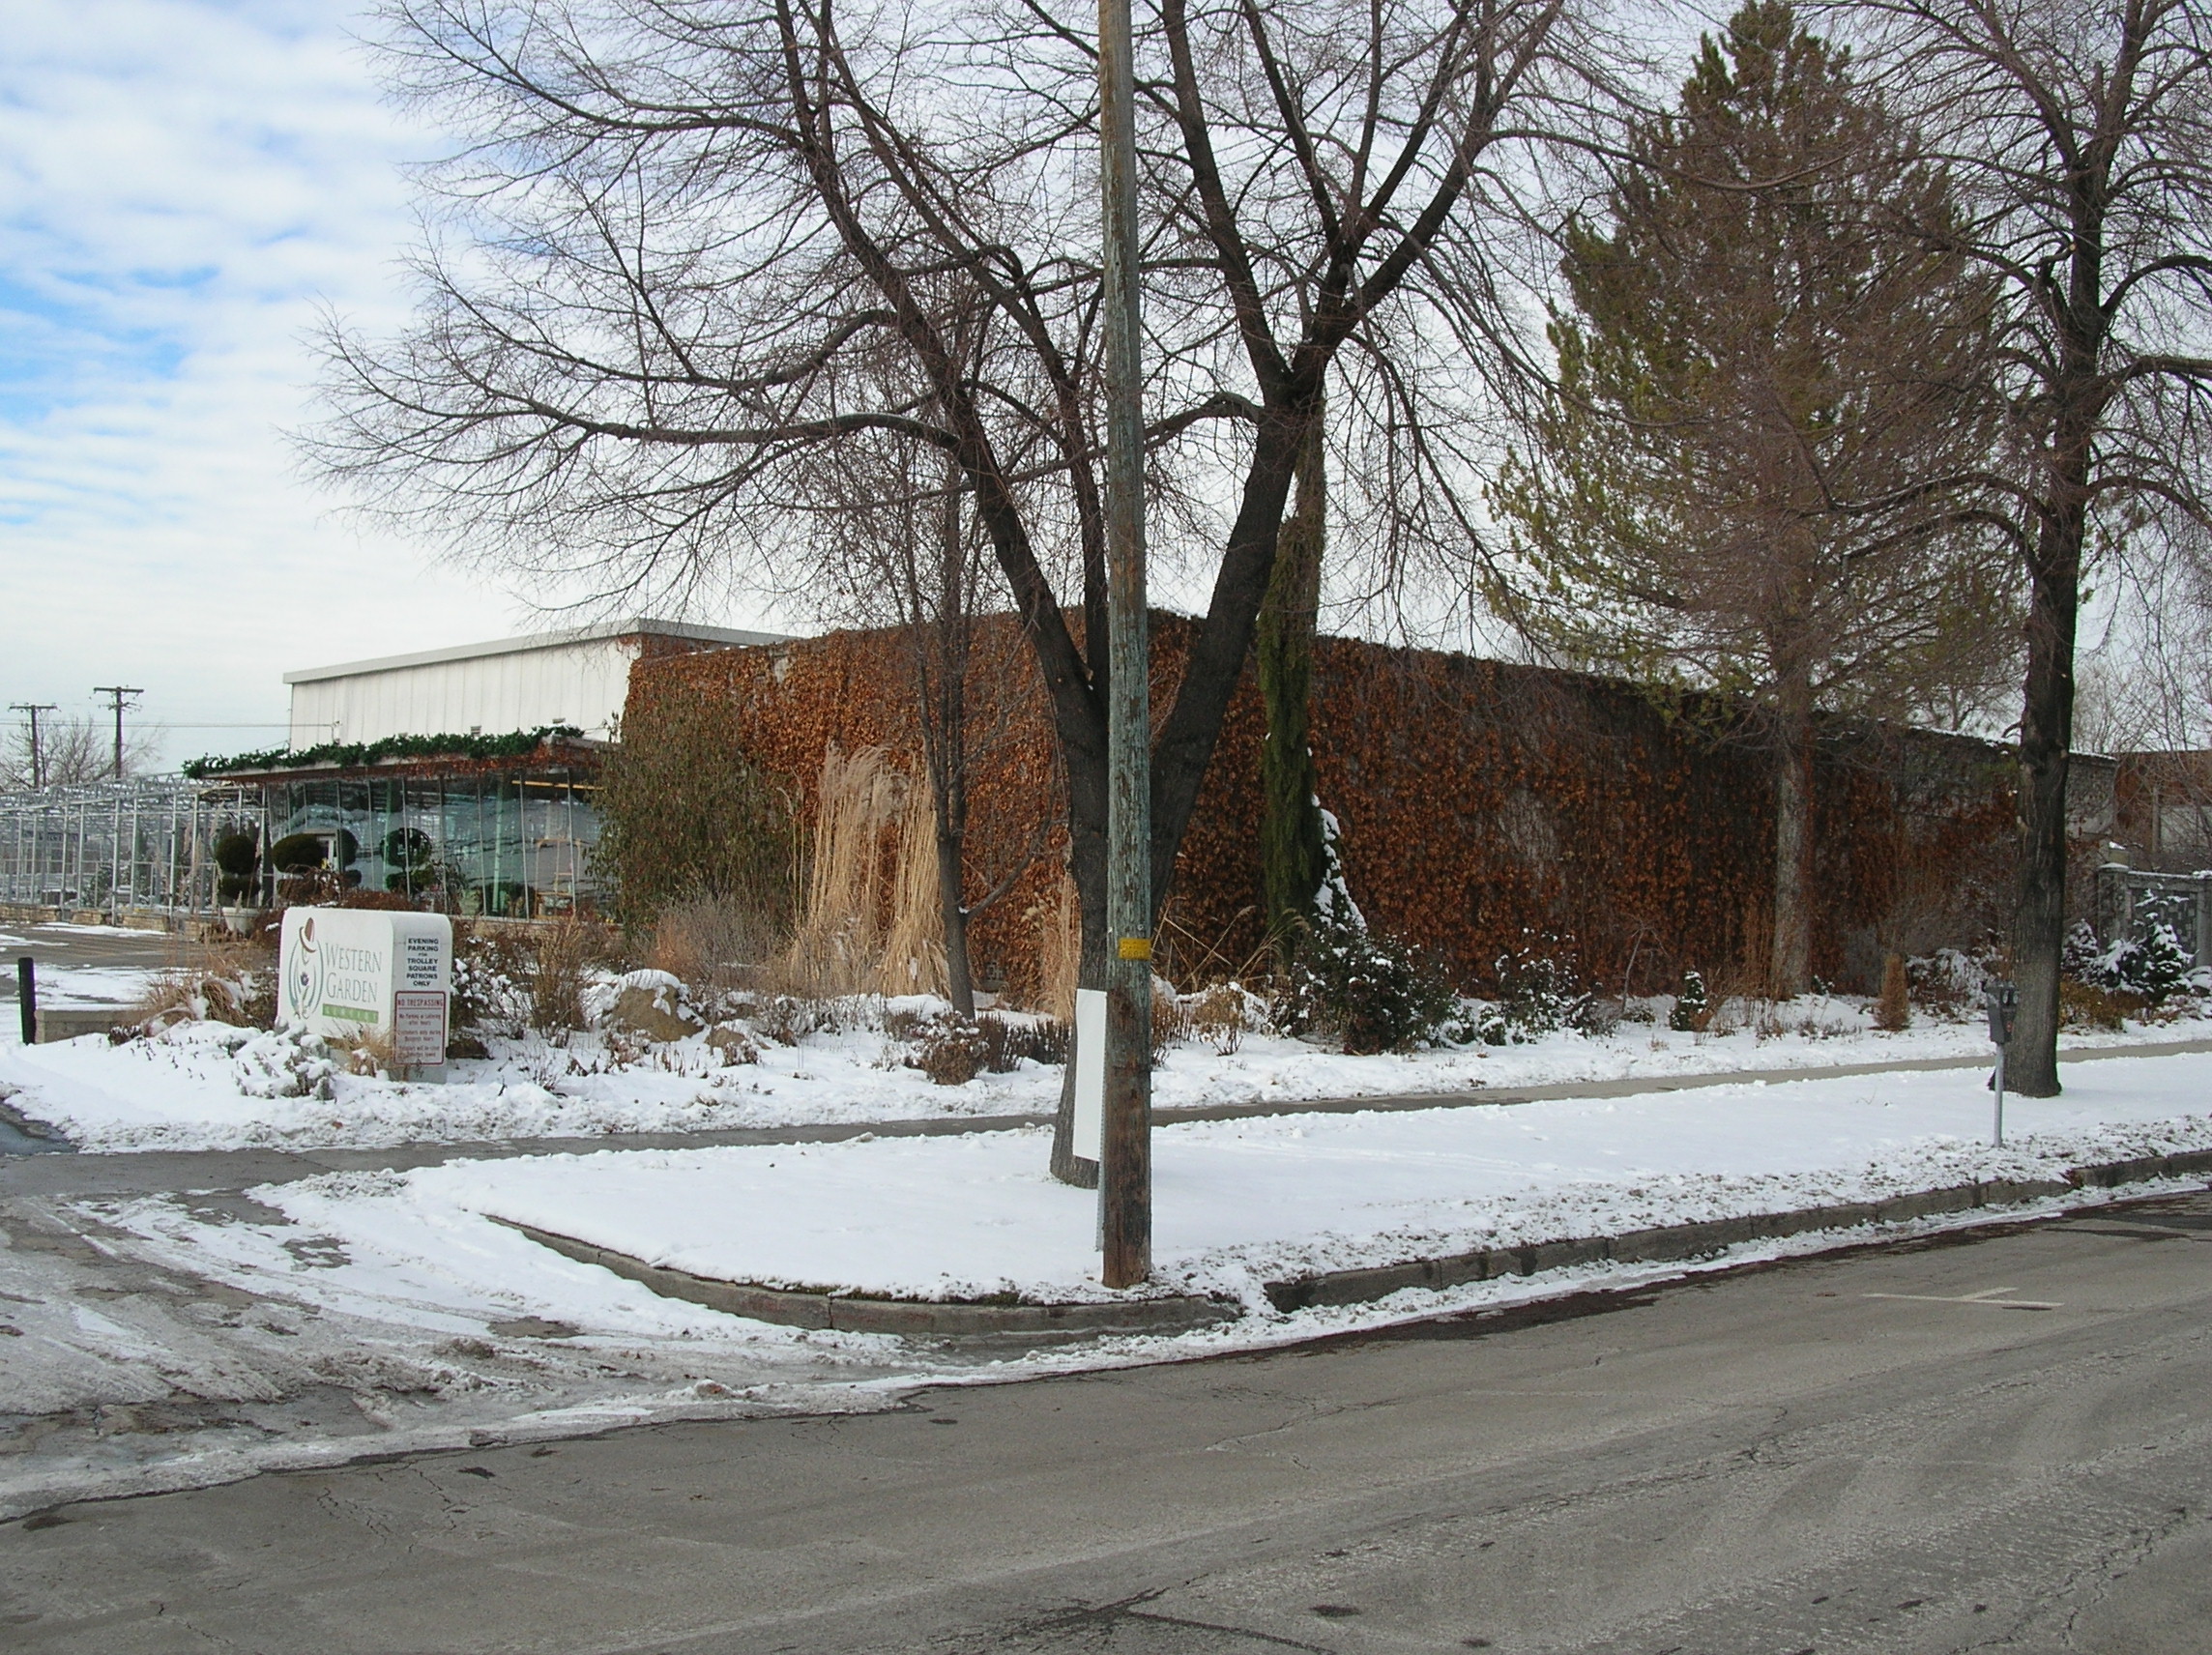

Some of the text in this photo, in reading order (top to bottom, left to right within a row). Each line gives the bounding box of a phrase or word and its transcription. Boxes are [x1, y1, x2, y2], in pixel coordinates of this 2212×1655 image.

[325, 943, 382, 973] WESTERN
[326, 972, 378, 1003] GARDEN
[407, 998, 443, 1007] TRESPASSING
